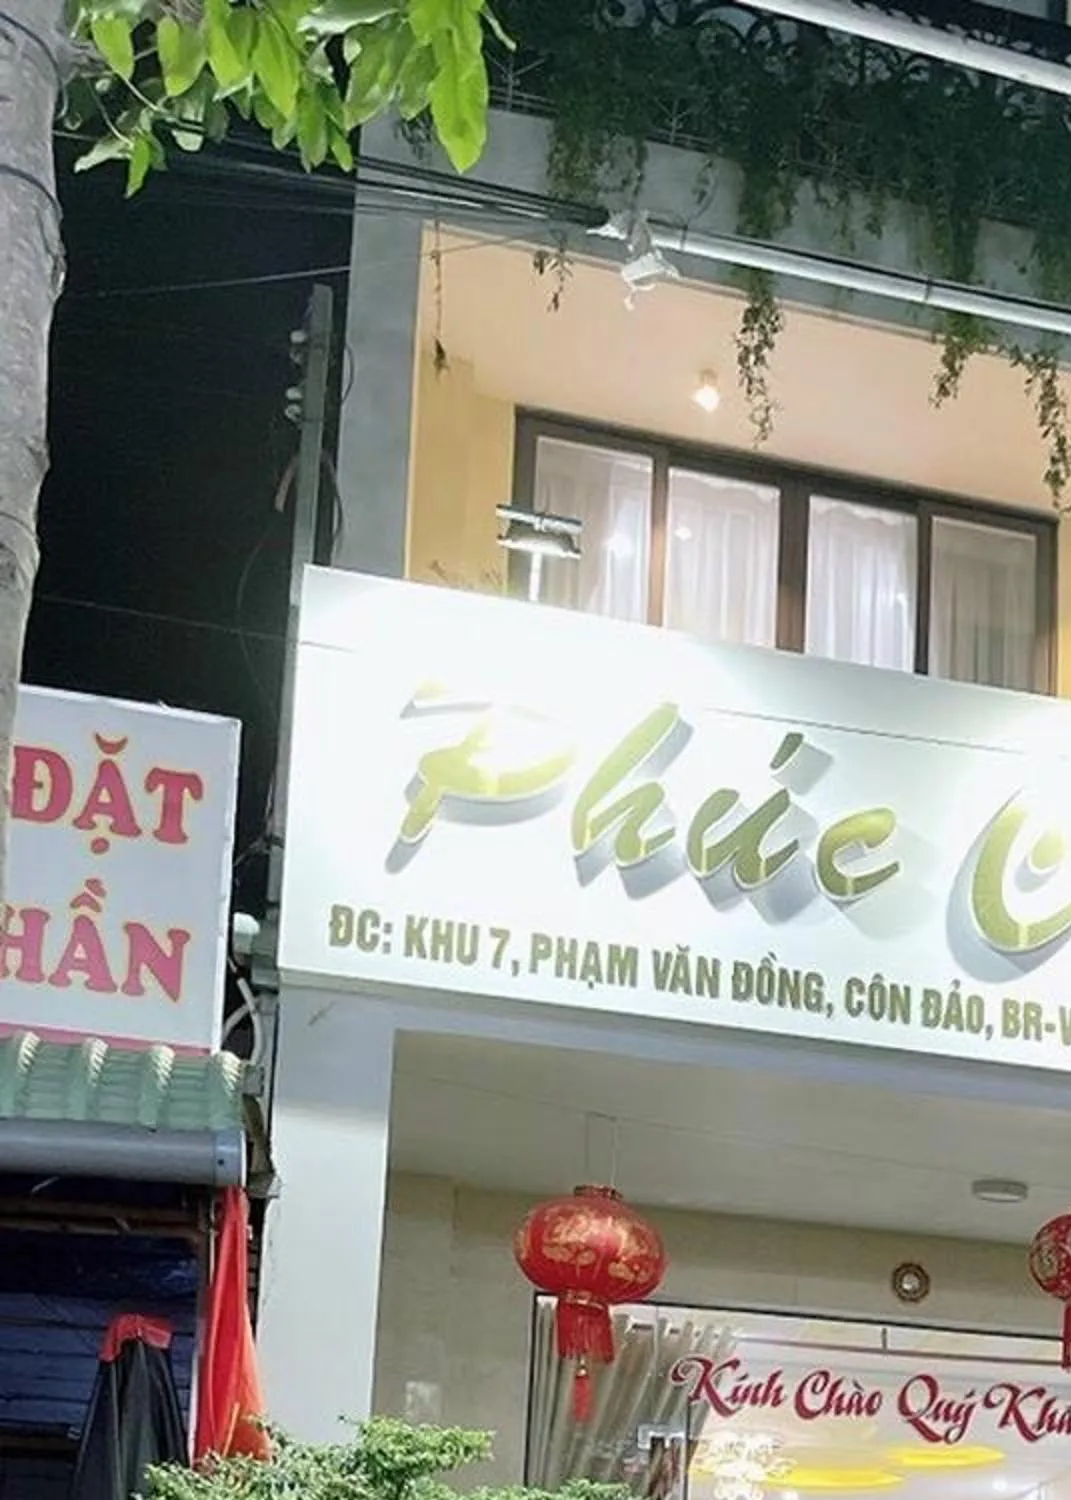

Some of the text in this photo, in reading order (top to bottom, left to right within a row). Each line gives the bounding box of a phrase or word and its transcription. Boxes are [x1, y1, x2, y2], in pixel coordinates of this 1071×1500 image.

[12, 733, 204, 854] ĐẶT
[400, 682, 900, 900] Phúc
[328, 903, 393, 954] ĐC:
[403, 914, 480, 967] KHU
[489, 926, 520, 977] 7,
[528, 932, 640, 991] PHẠM
[652, 943, 721, 999] VĂN
[731, 951, 834, 1019] ĐỒNG,
[845, 972, 911, 1026] CÔN
[920, 979, 993, 1040] ĐẢO,
[671, 1356, 785, 1418] Kính
[794, 1369, 883, 1420] Chào
[897, 1374, 977, 1445] Quý
